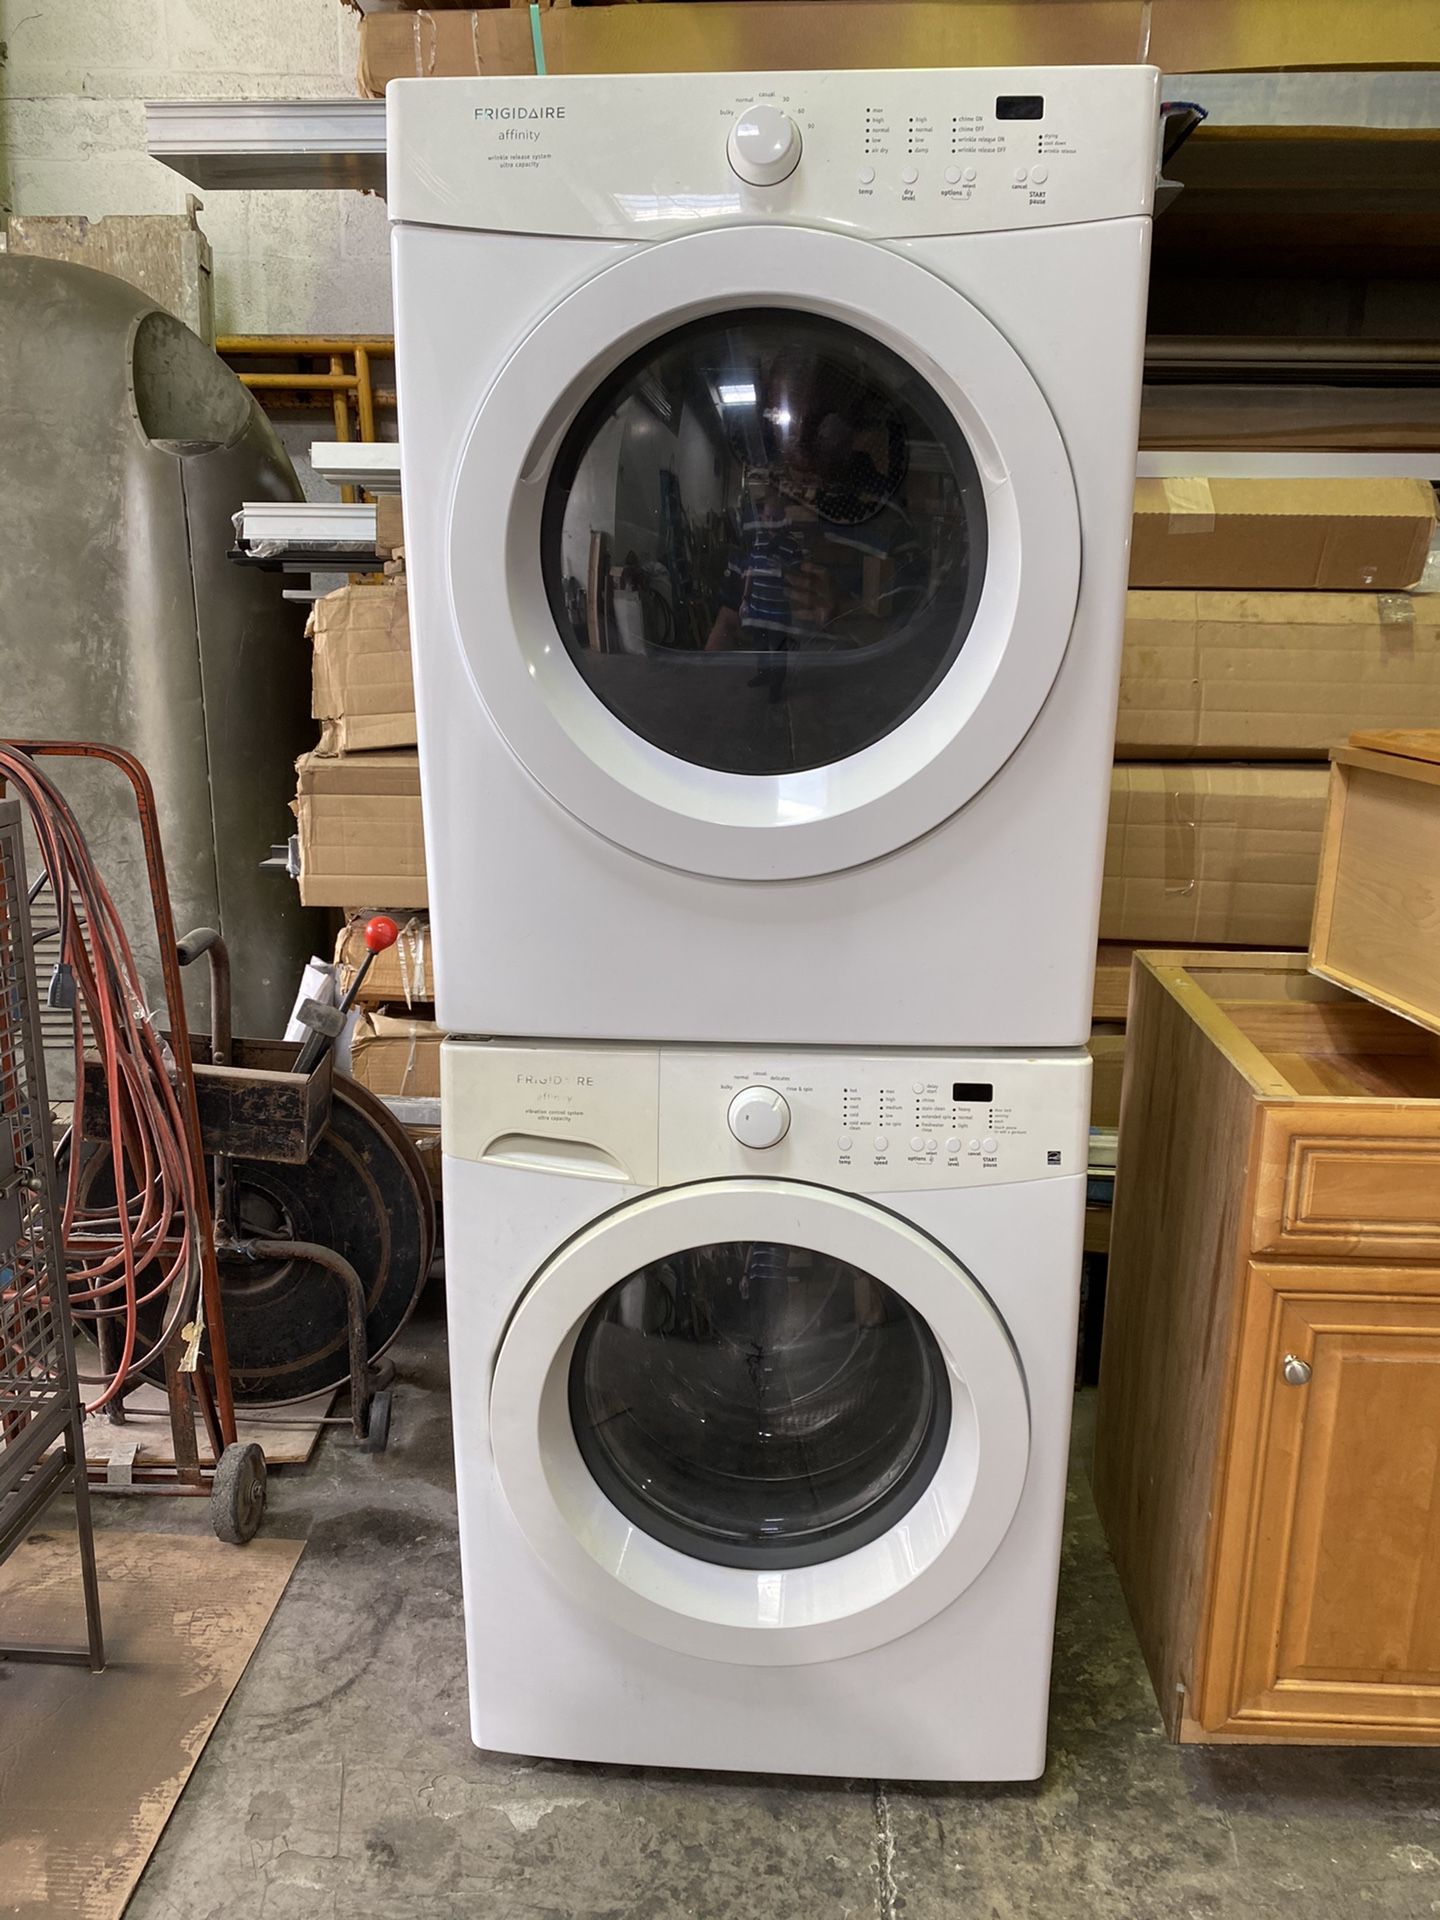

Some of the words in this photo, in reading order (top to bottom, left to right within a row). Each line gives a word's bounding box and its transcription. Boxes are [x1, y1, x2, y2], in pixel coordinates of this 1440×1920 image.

[474, 107, 565, 120] FRIGIDAIRE
[498, 129, 540, 142] affinity
[517, 1074, 594, 1086] FRGIDRE
